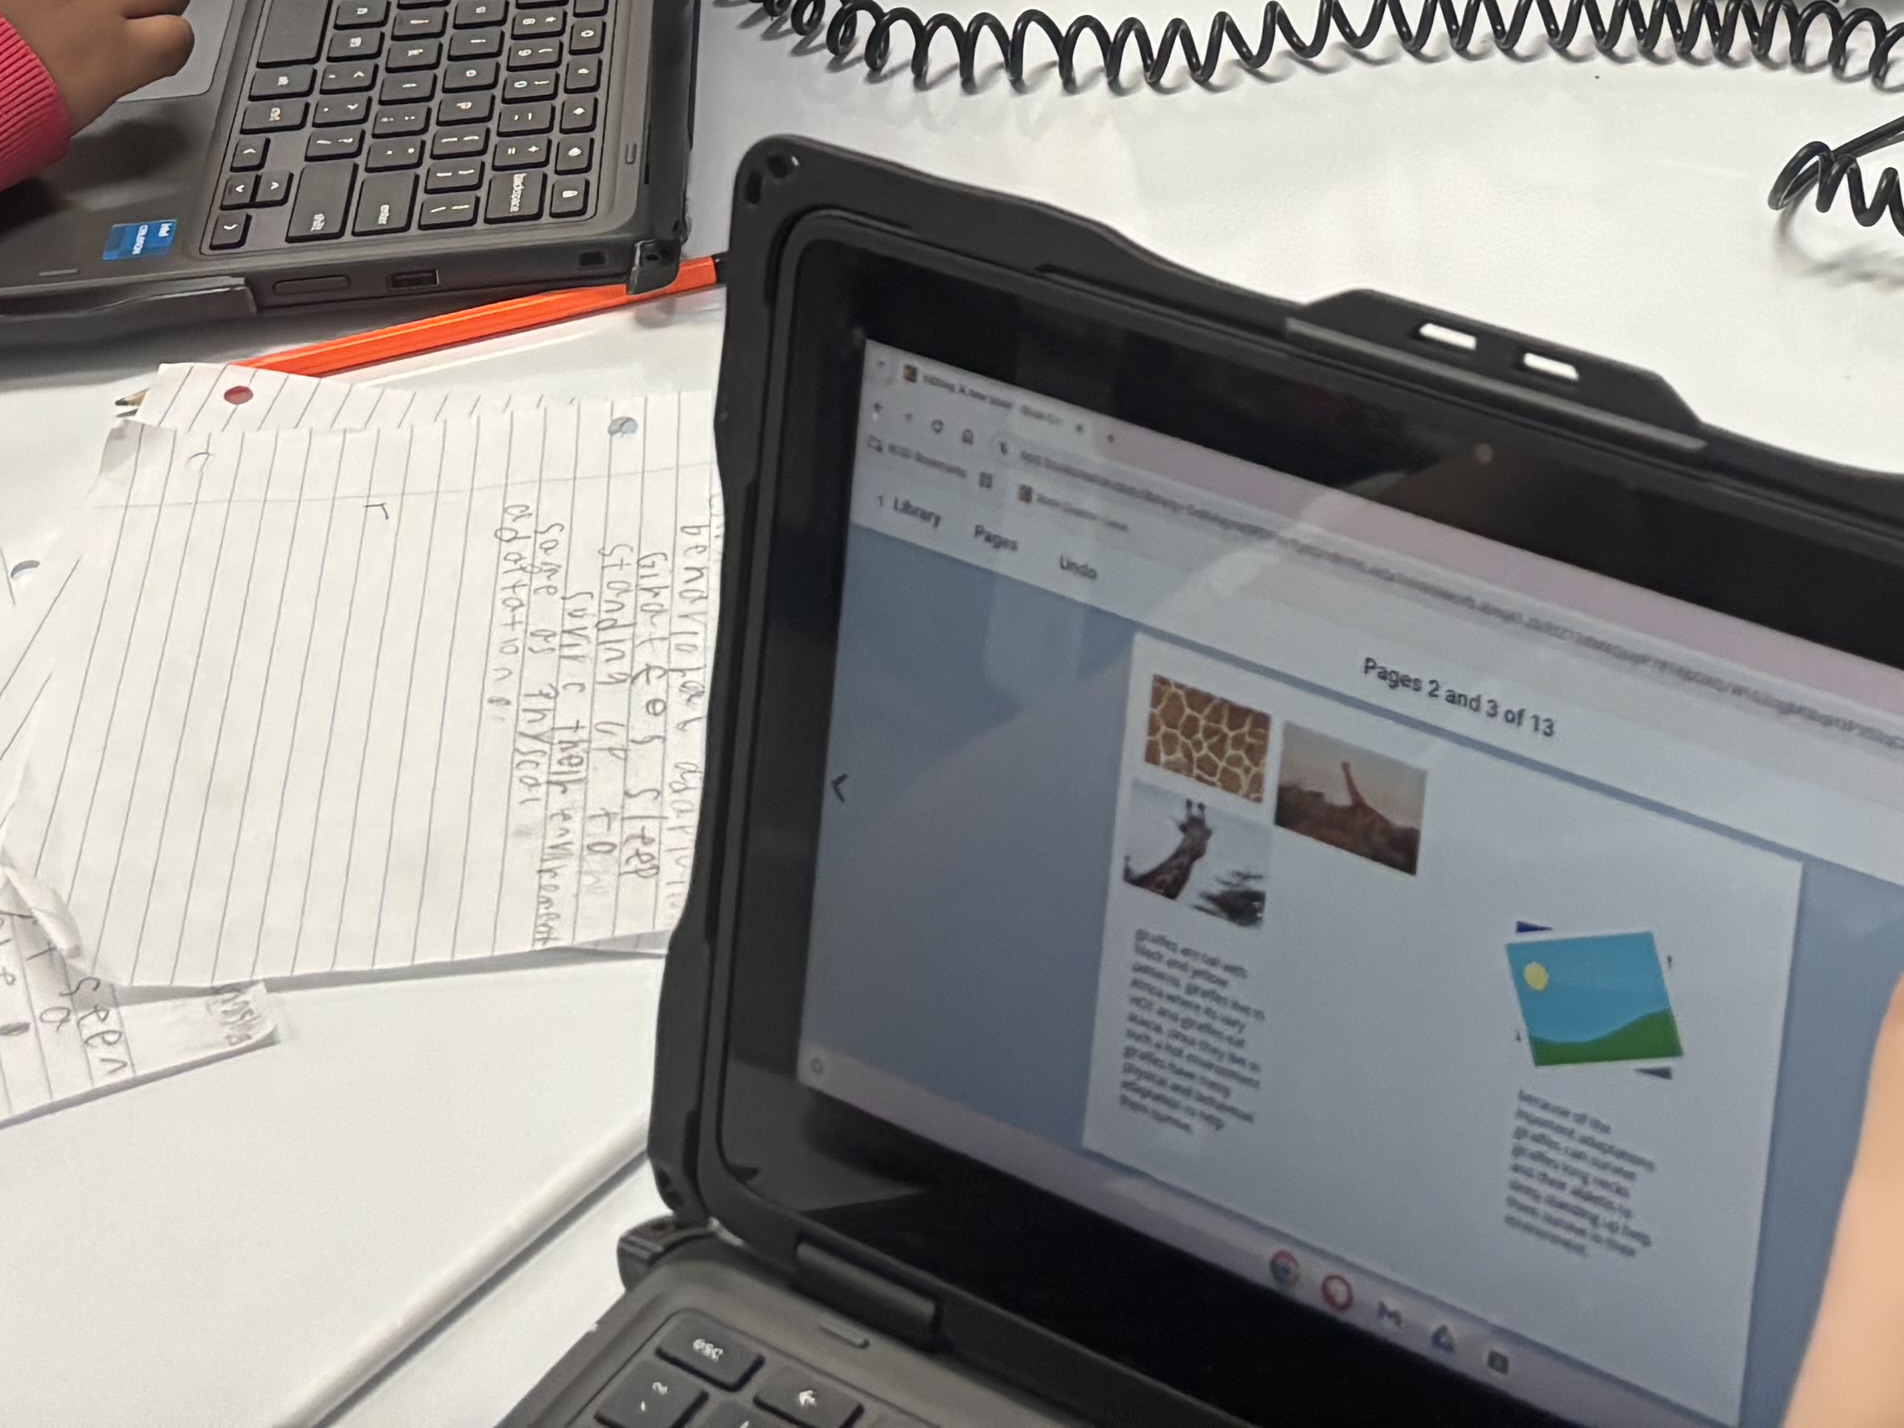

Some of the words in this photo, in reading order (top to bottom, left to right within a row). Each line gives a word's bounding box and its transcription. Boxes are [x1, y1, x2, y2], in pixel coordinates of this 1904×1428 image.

[509, 173, 528, 214] backspace
[893, 496, 941, 529] Library
[974, 523, 1019, 553] Pages
[1059, 553, 1098, 582] Undo
[1363, 656, 1423, 692] Pages
[1428, 679, 1440, 698] 2
[1445, 689, 1481, 712] and
[1486, 699, 1498, 717] 3
[1504, 708, 1526, 727] of
[1530, 714, 1555, 738] 13
[692, 1338, 725, 1362] esc
